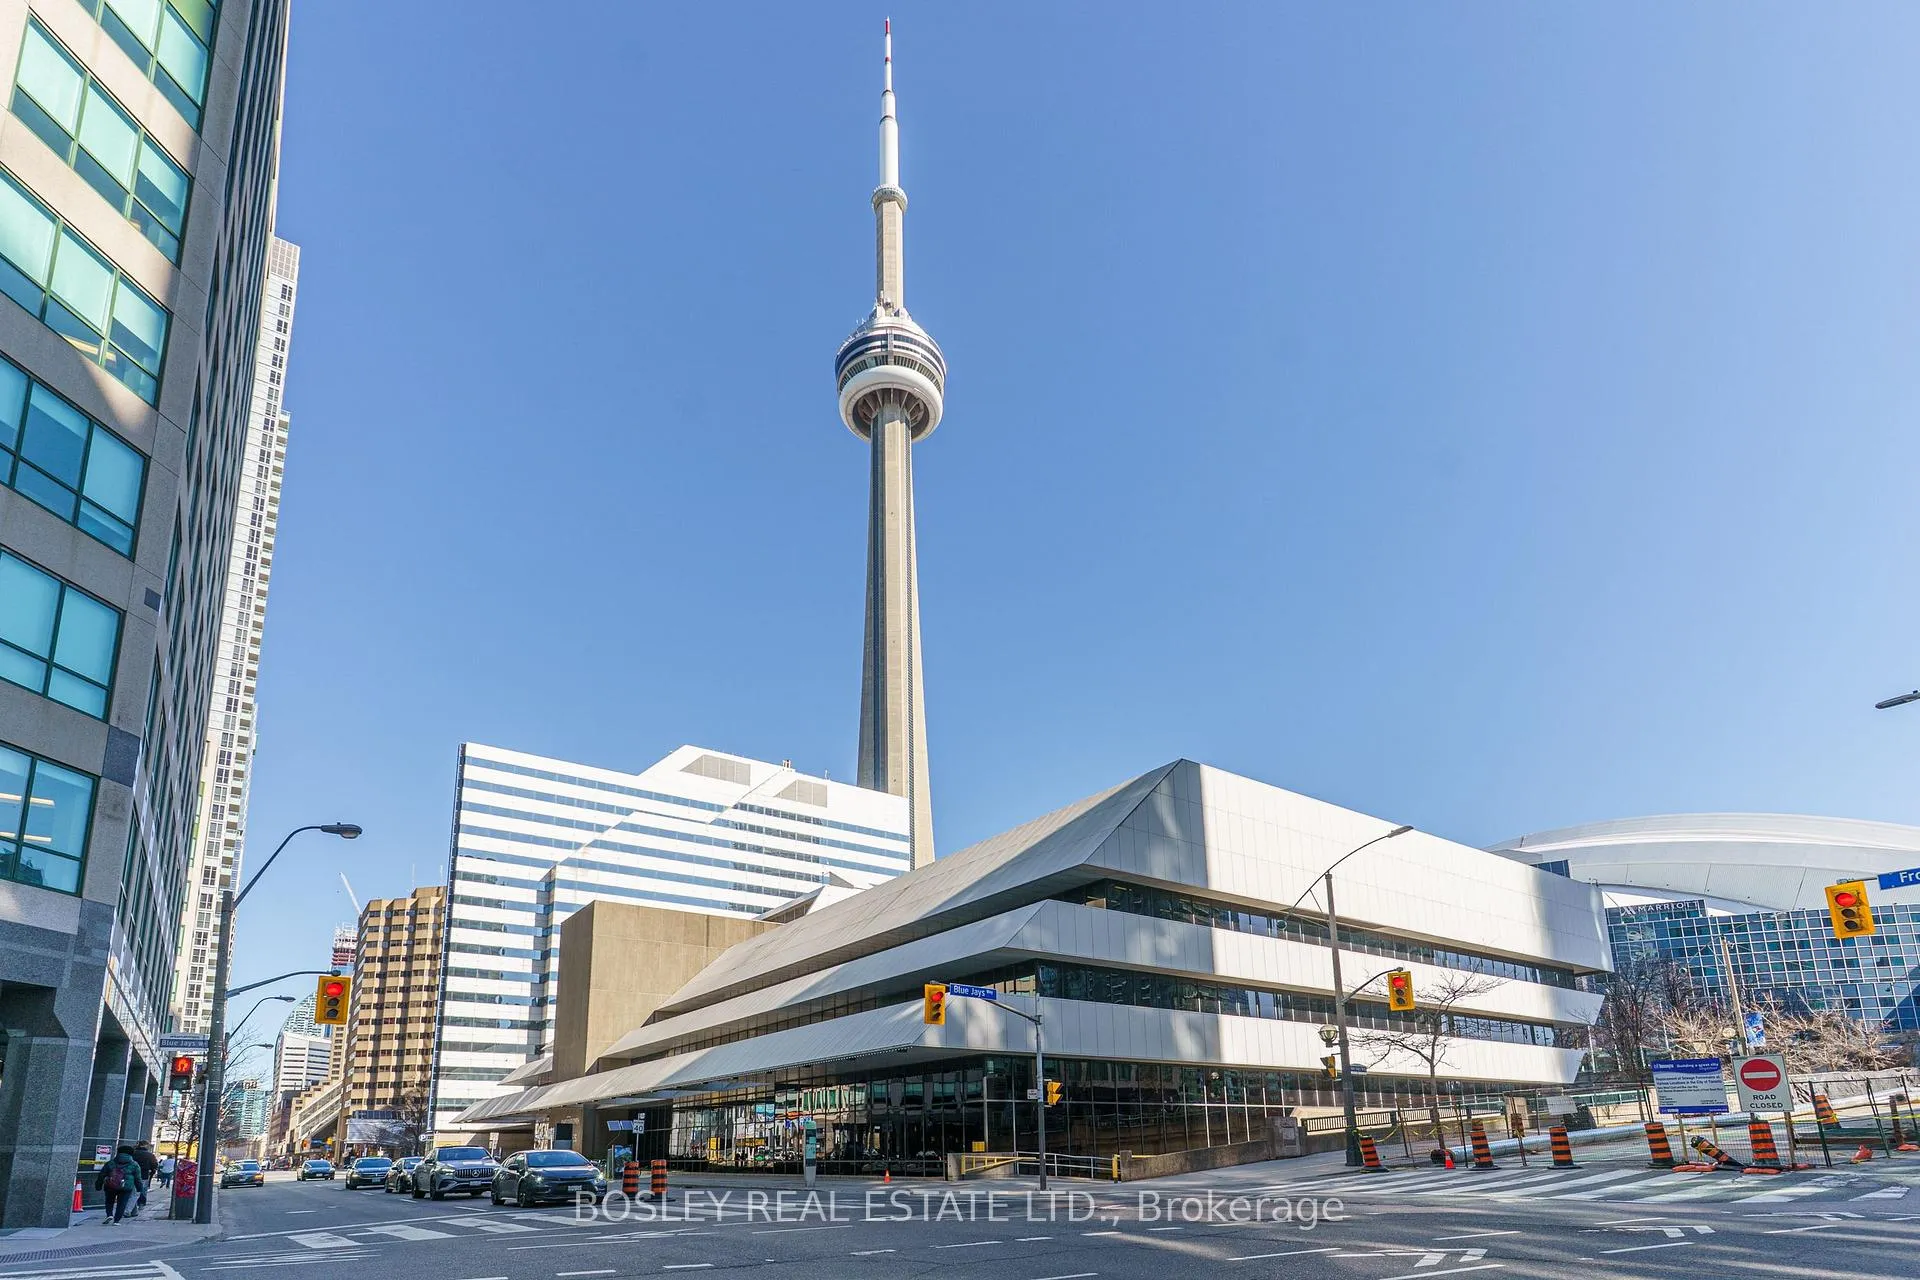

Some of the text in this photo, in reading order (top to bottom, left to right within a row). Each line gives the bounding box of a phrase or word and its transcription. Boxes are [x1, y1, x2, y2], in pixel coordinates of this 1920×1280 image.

[1637, 902, 1698, 912] MARRIOTT
[953, 985, 969, 995] Blue
[970, 987, 986, 998] Jays
[180, 1040, 196, 1048] Jays
